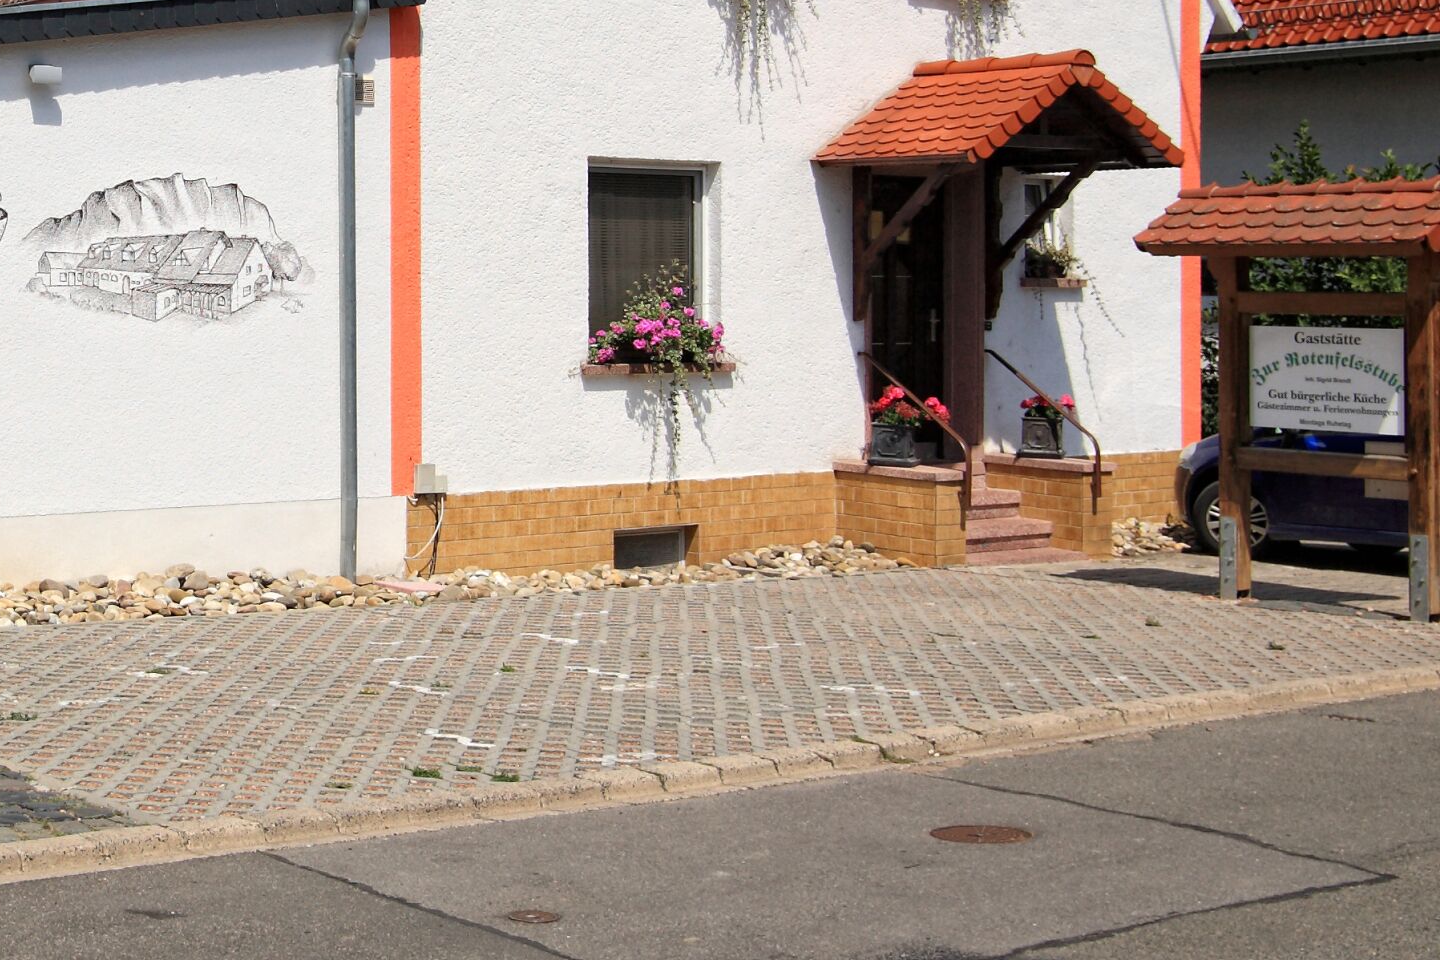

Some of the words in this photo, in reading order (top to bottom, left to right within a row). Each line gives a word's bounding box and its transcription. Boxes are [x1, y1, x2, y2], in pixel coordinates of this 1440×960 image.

[1294, 331, 1362, 346] Gaststätte
[1251, 358, 1280, 386] Zur
[1285, 351, 1404, 394] Rotenfelsstube
[1268, 389, 1288, 400] Gut
[1291, 390, 1350, 403] bürgerliche
[1353, 392, 1387, 404] Küche
[1257, 401, 1311, 412] Gästezimmer
[1313, 405, 1320, 413] u.
